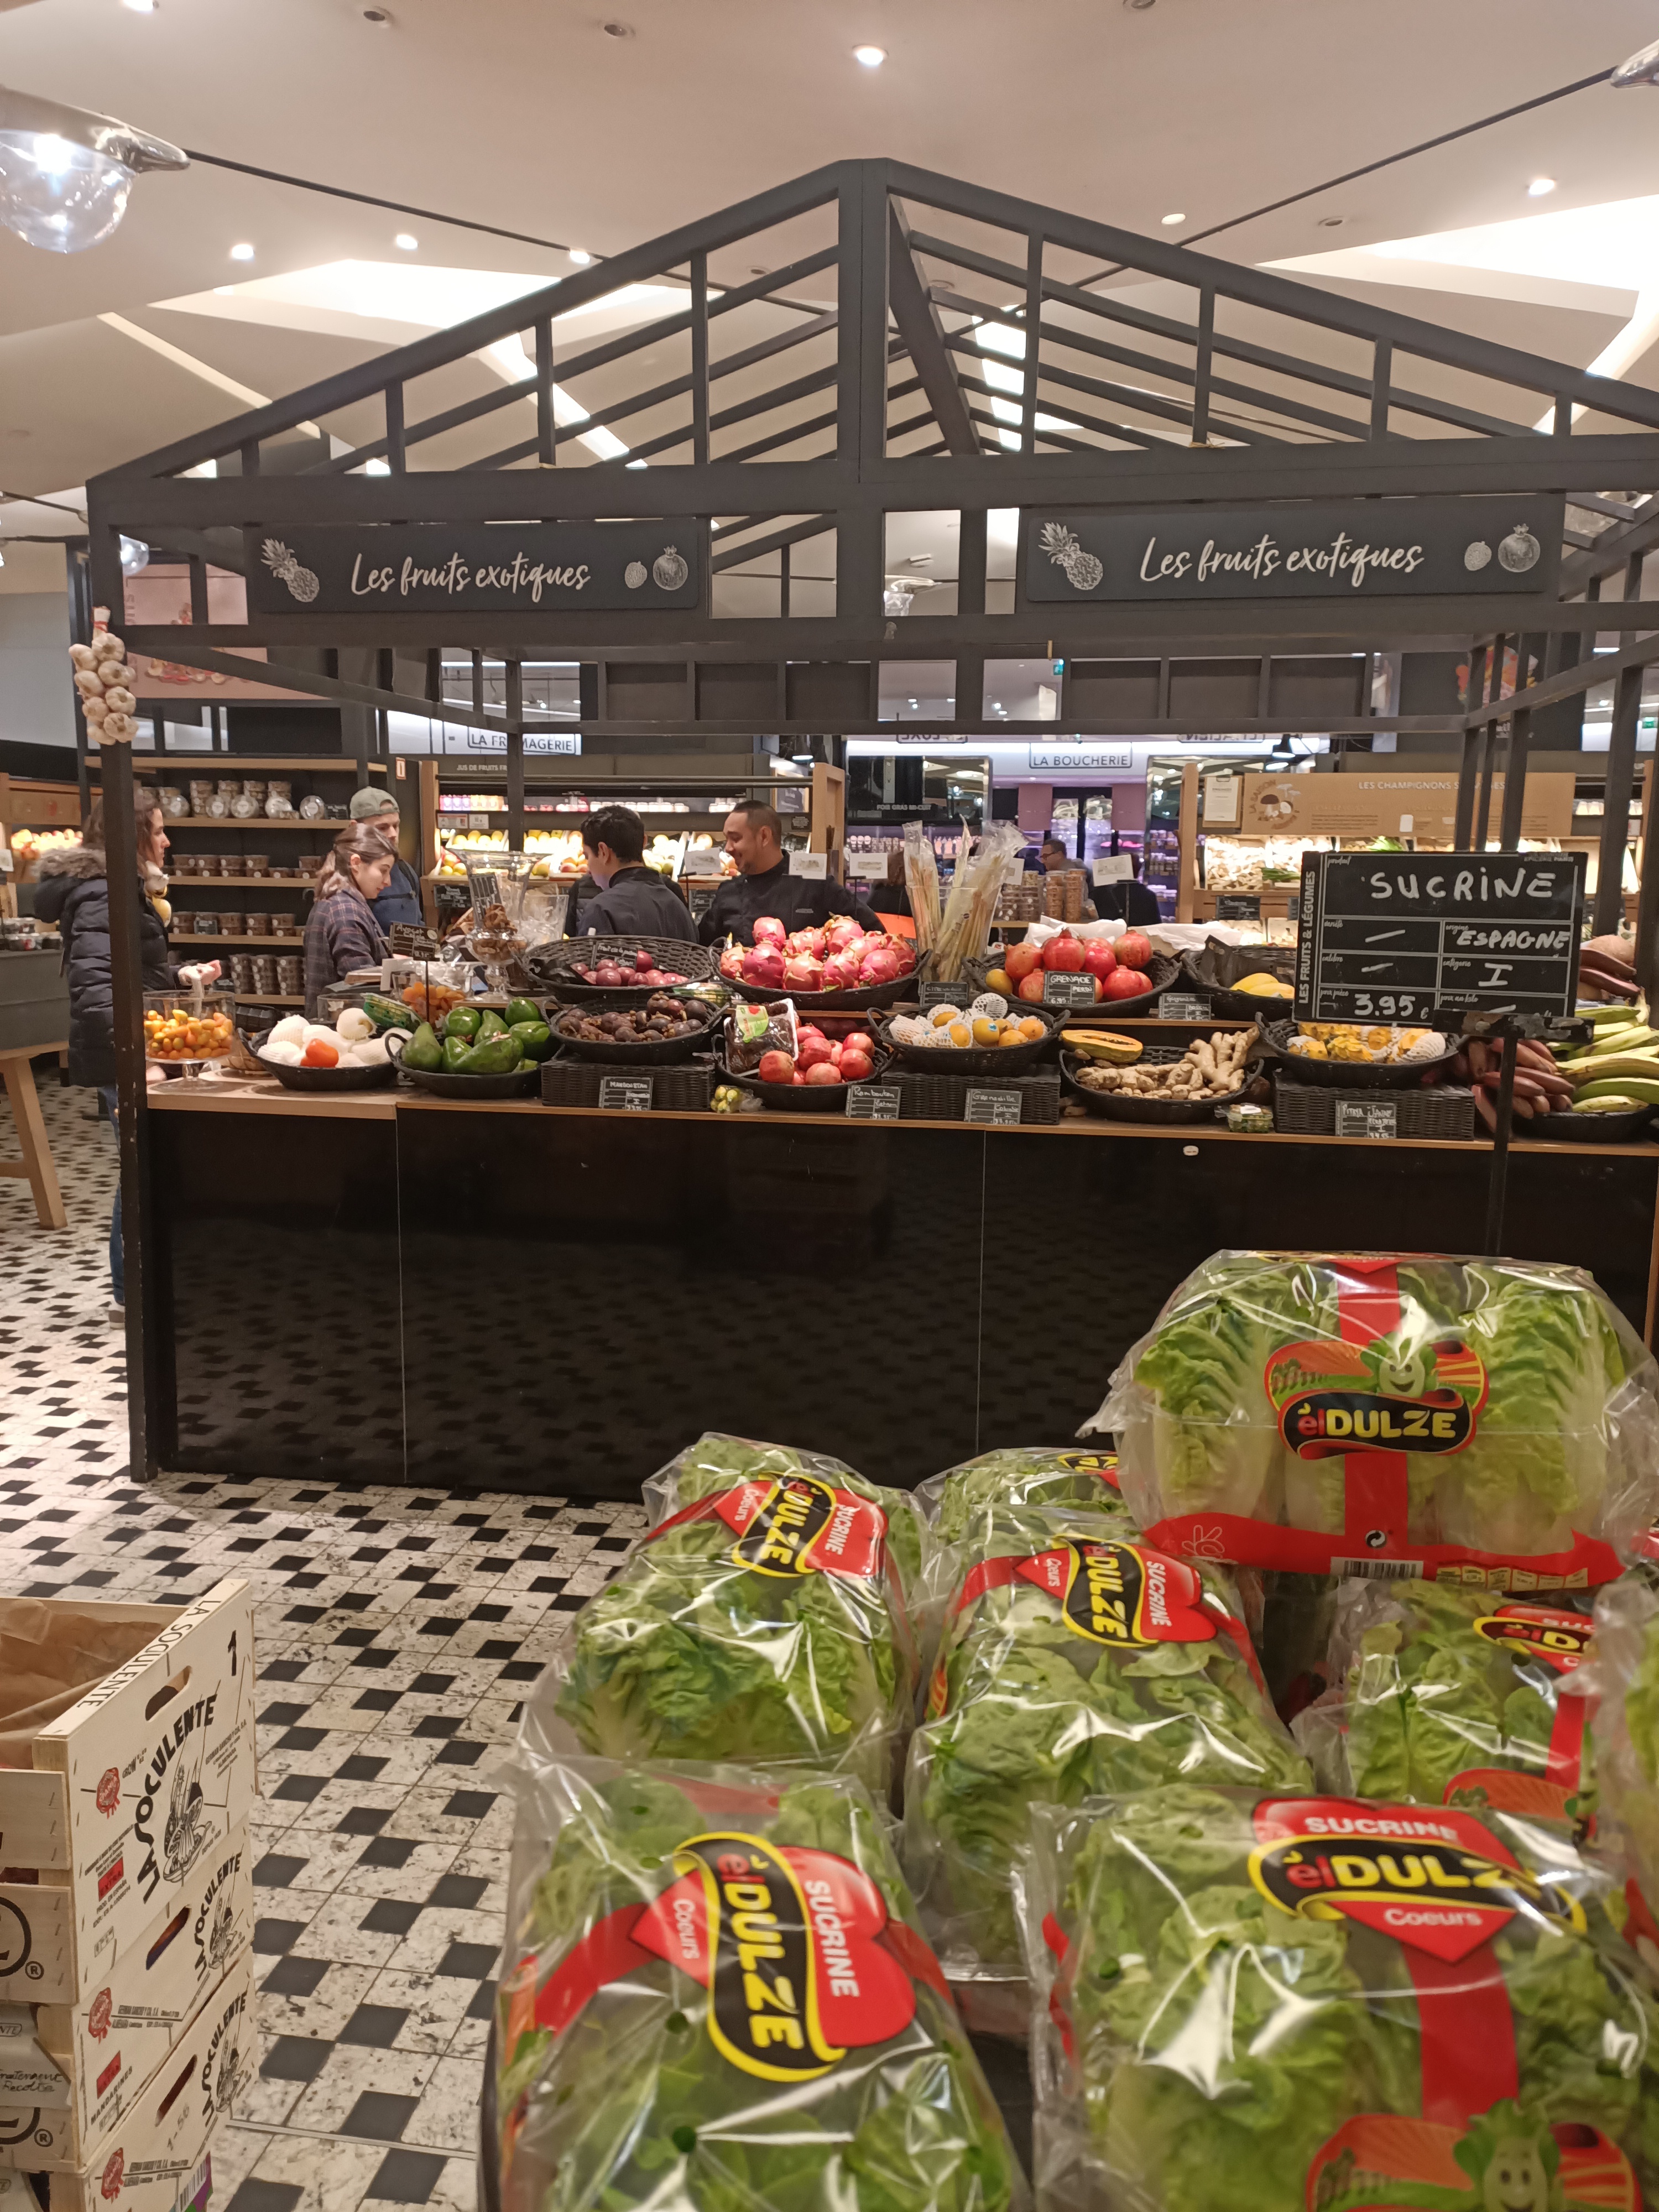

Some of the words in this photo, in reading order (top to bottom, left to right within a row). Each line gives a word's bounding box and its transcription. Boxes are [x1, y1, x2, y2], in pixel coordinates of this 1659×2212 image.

[1140, 538, 1193, 582] Les
[1198, 534, 1282, 582] fruits
[1286, 532, 1425, 587] exotiques
[351, 553, 395, 596] Les
[400, 552, 471, 596] fruits
[476, 551, 591, 603] exotiques
[471, 733, 487, 746] LA
[1034, 756, 1049, 766] LA
[1054, 755, 1129, 766] BOUCHERIE
[1358, 781, 1375, 790] LES
[1377, 781, 1452, 791] CHAMPIGNONS
[1302, 870, 1316, 925] LÉGUMES
[1370, 867, 1556, 901] SUCRINE
[1303, 928, 1312, 938] &
[1457, 930, 1571, 950] ESPAGNE
[1300, 941, 1312, 979] FRUITS
[1478, 962, 1514, 987] I
[1050, 974, 1092, 985] GRENADE
[1298, 982, 1309, 1004] LES
[1354, 993, 1416, 1017] 3.95
[734, 1488, 760, 1521] Coeurs
[825, 1503, 855, 1556] SUCRINE
[1045, 1557, 1061, 1587] Coeurs
[186, 1600, 222, 1616] LA
[1146, 1561, 1172, 1627] SUCRINE
[134, 1693, 217, 1848] SOCULENTE
[1304, 1816, 1458, 1841] SUCRINE
[137, 1848, 160, 1905] LA
[194, 1851, 242, 1955] SOCULENTE
[1384, 1907, 1484, 1927] Coeurs
[672, 1898, 700, 1960] Coeurs
[805, 1880, 860, 1997] SUCRINE
[194, 1954, 207, 1981] LA
[201, 1990, 248, 2101] SOCULENTE
[91, 2065, 133, 2126] MANDARINES
